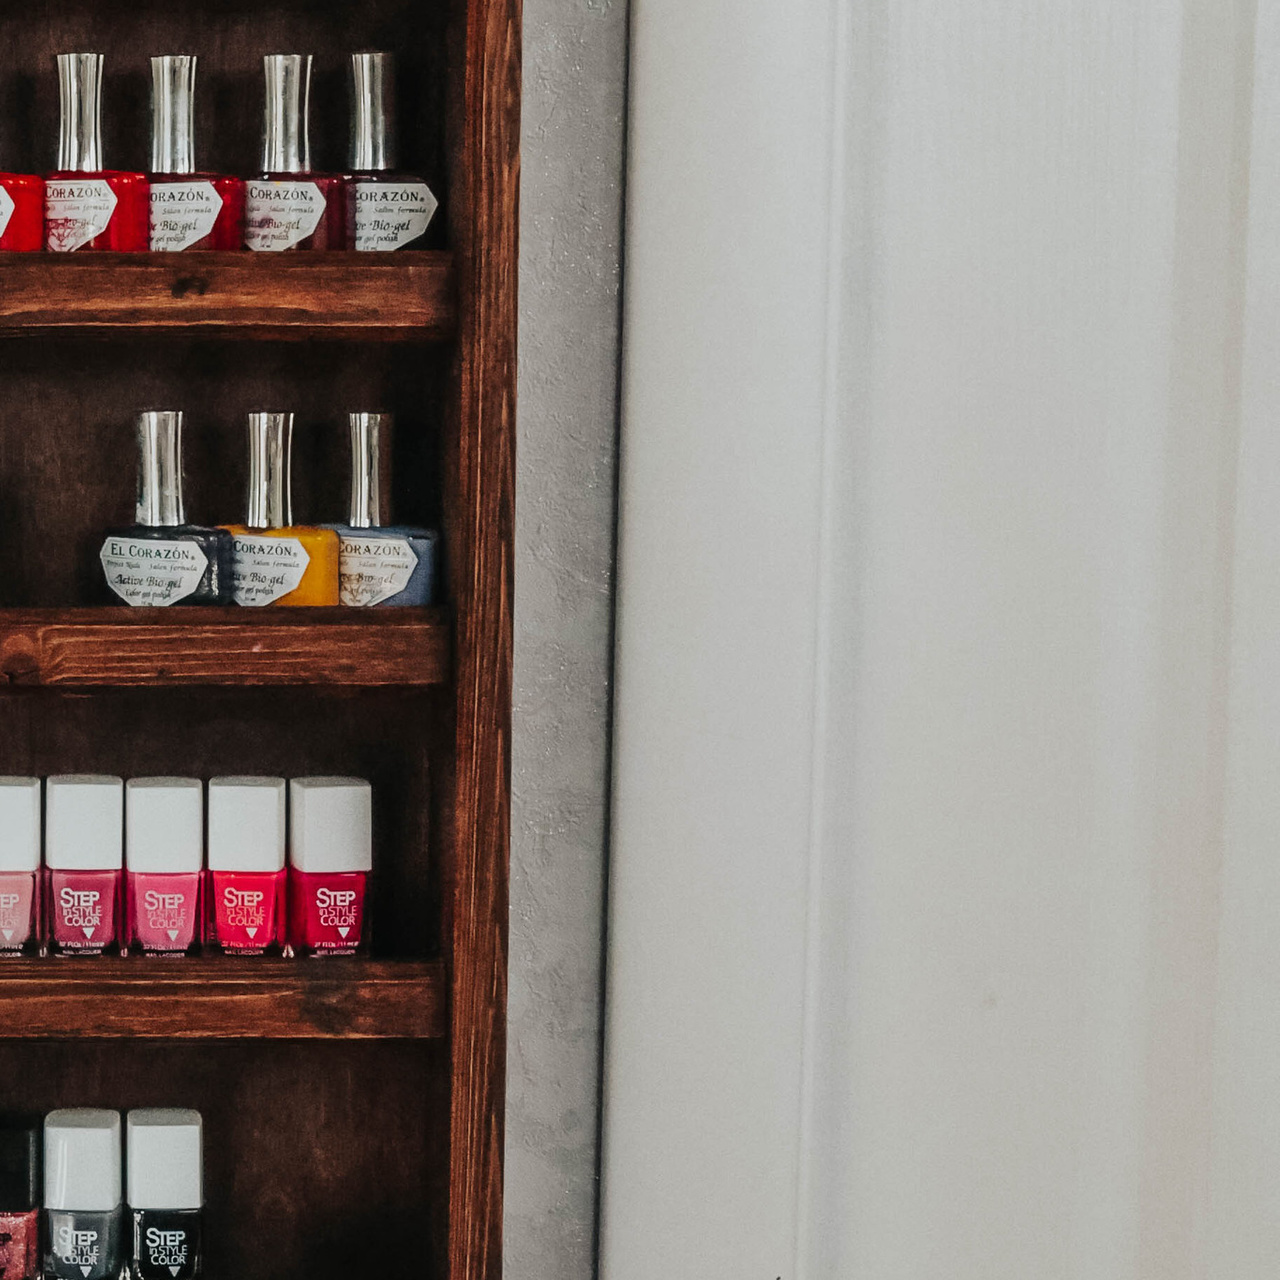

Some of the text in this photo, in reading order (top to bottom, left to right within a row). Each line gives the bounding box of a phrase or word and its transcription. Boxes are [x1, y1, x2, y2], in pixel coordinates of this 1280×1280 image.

[150, 188, 204, 203] ORAZÓN
[250, 186, 308, 200] CORAZÓN
[111, 543, 190, 559] EL CORAZÓN
[233, 540, 292, 556] CORAZÓN
[60, 887, 100, 908] STEP
[144, 890, 184, 910] STEP
[224, 887, 264, 907] STEP
[316, 887, 356, 907] STEP
[65, 917, 101, 926] COLOR
[228, 915, 263, 926] COLOR
[320, 915, 355, 926] COLOR
[59, 1227, 98, 1246] STEP
[146, 1227, 186, 1247] STEP
[63, 1255, 97, 1265] COLOR
[151, 1255, 186, 1265] COLOR
